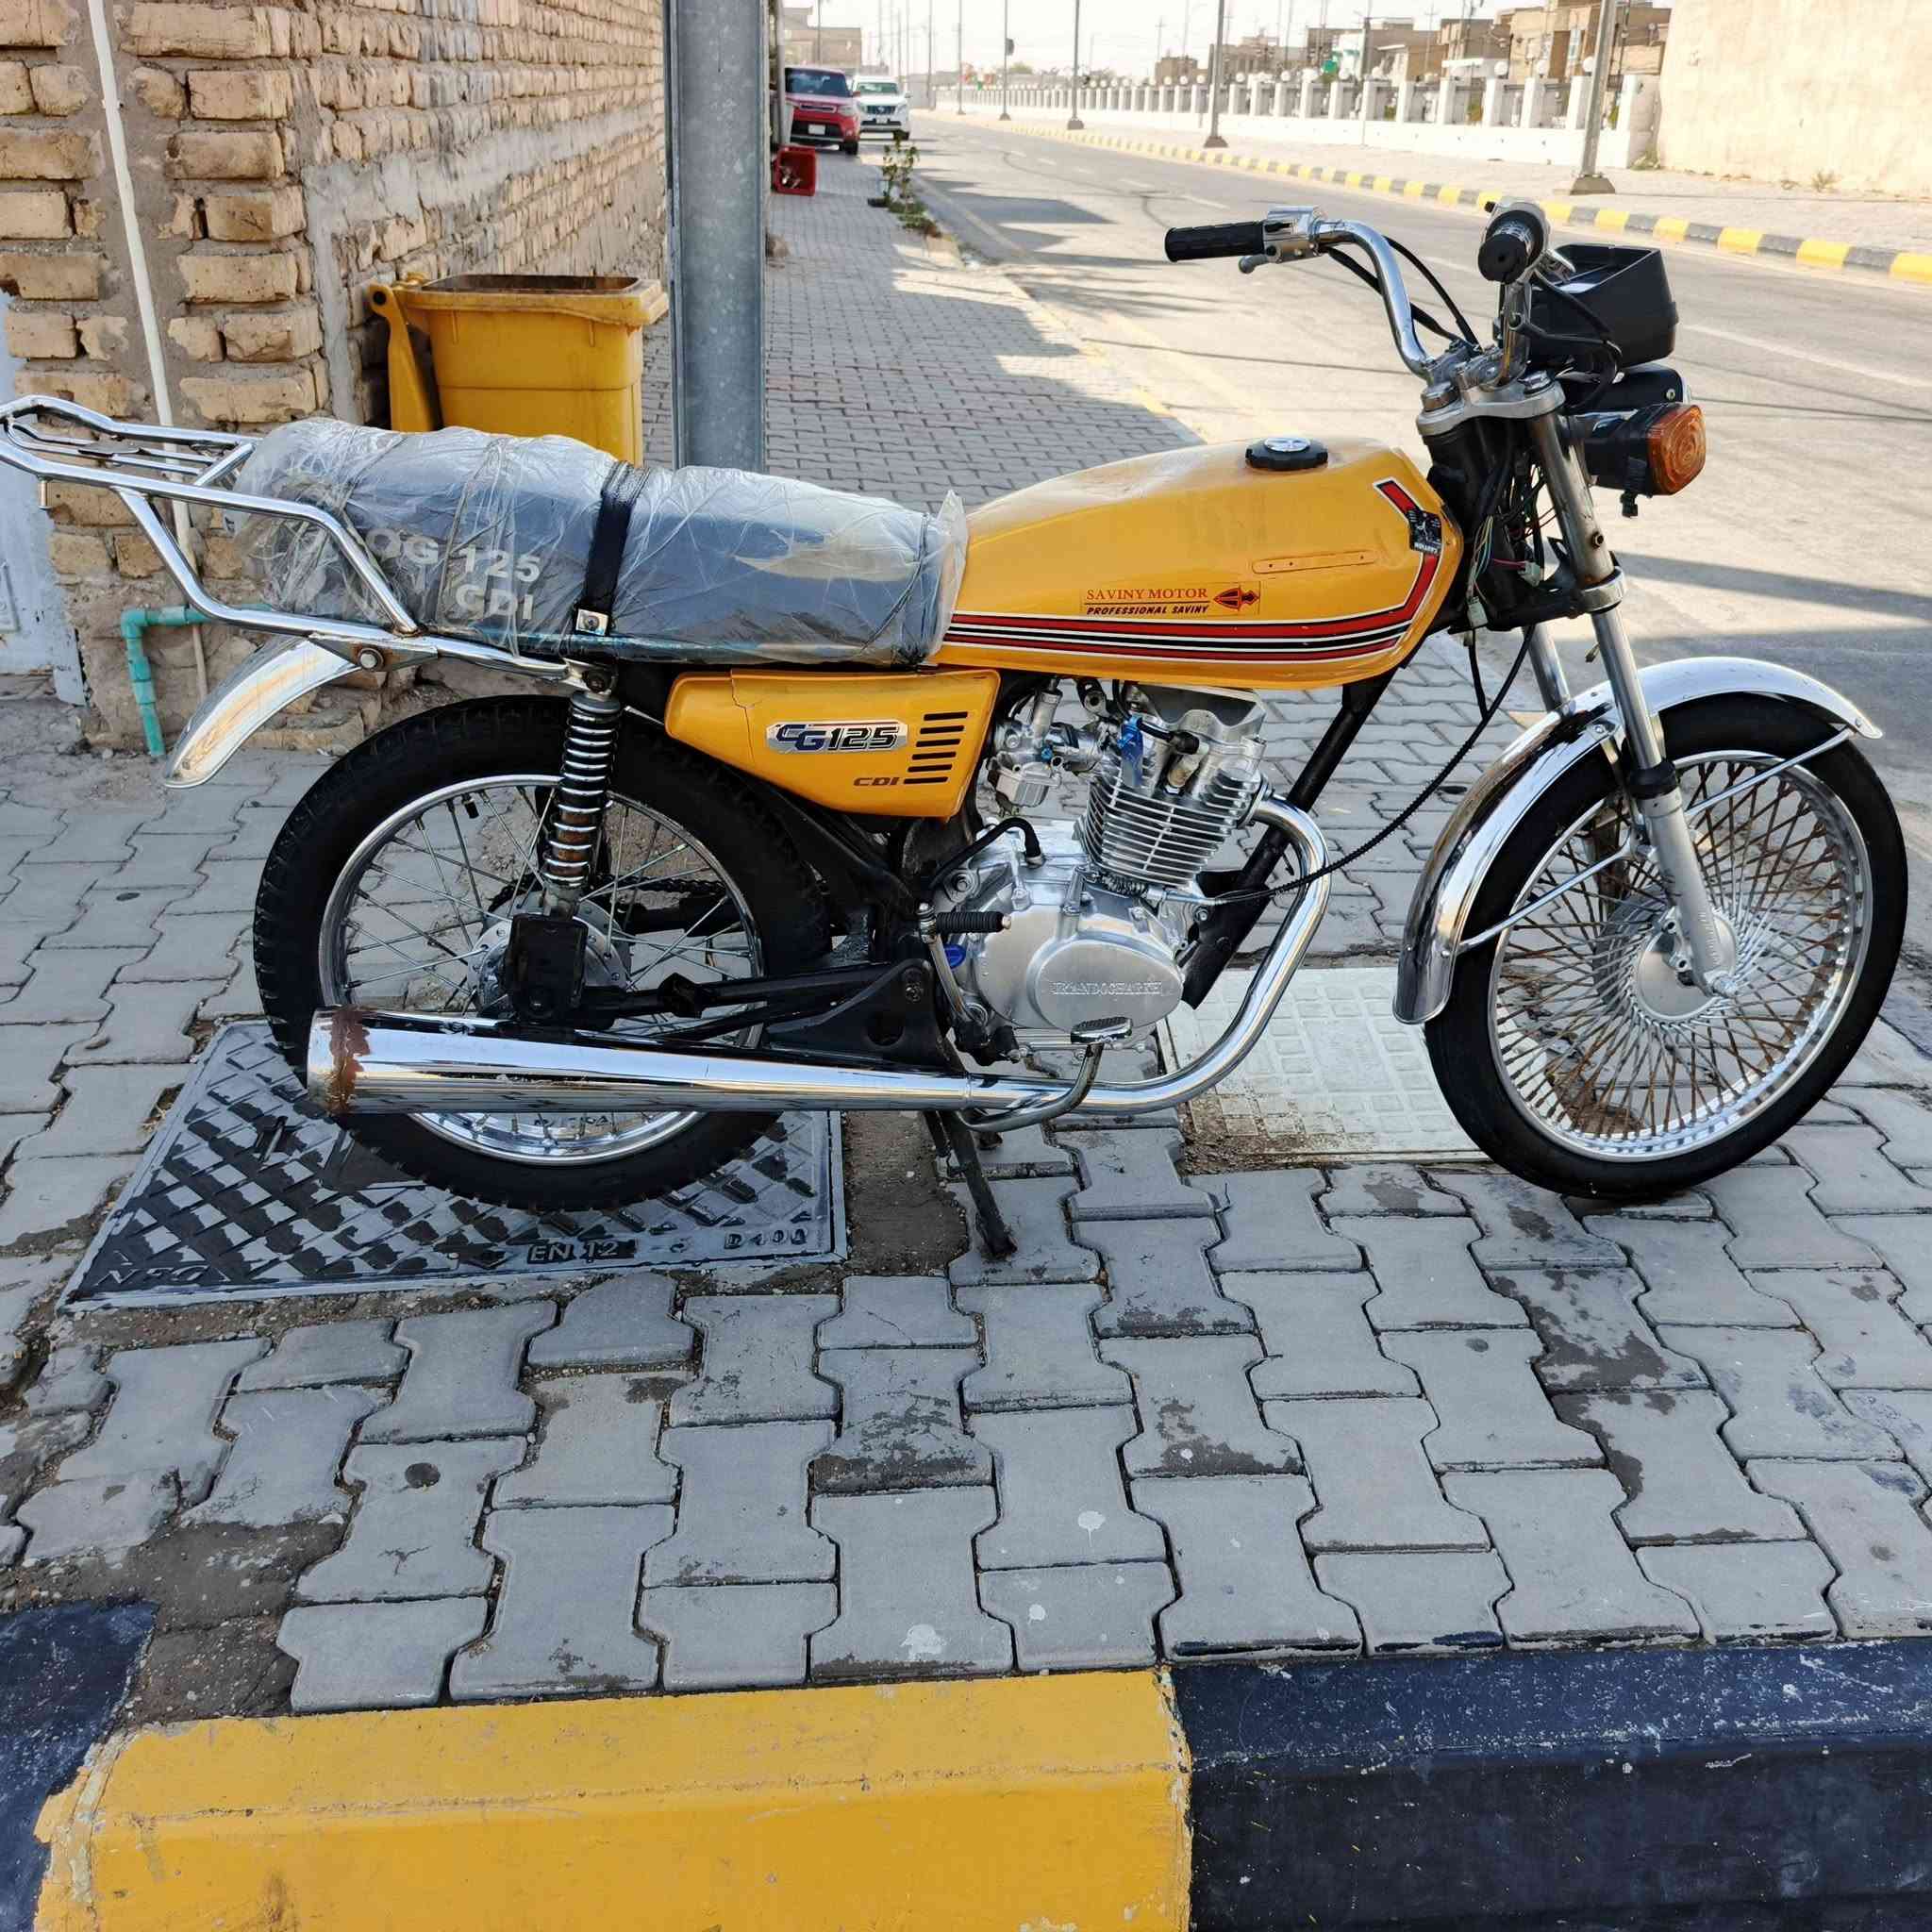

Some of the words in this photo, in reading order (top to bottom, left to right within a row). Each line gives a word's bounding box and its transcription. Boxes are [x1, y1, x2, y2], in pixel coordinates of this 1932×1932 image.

[459, 541, 541, 583] 125
[1086, 589, 1145, 600] SAVINY
[1147, 588, 1208, 599] MOTOR
[456, 583, 534, 621] CDI
[1086, 606, 1168, 615] PROFESSIONAL
[1172, 605, 1210, 614] SAVINY
[853, 776, 901, 787] CDI
[529, 1243, 574, 1262] EN
